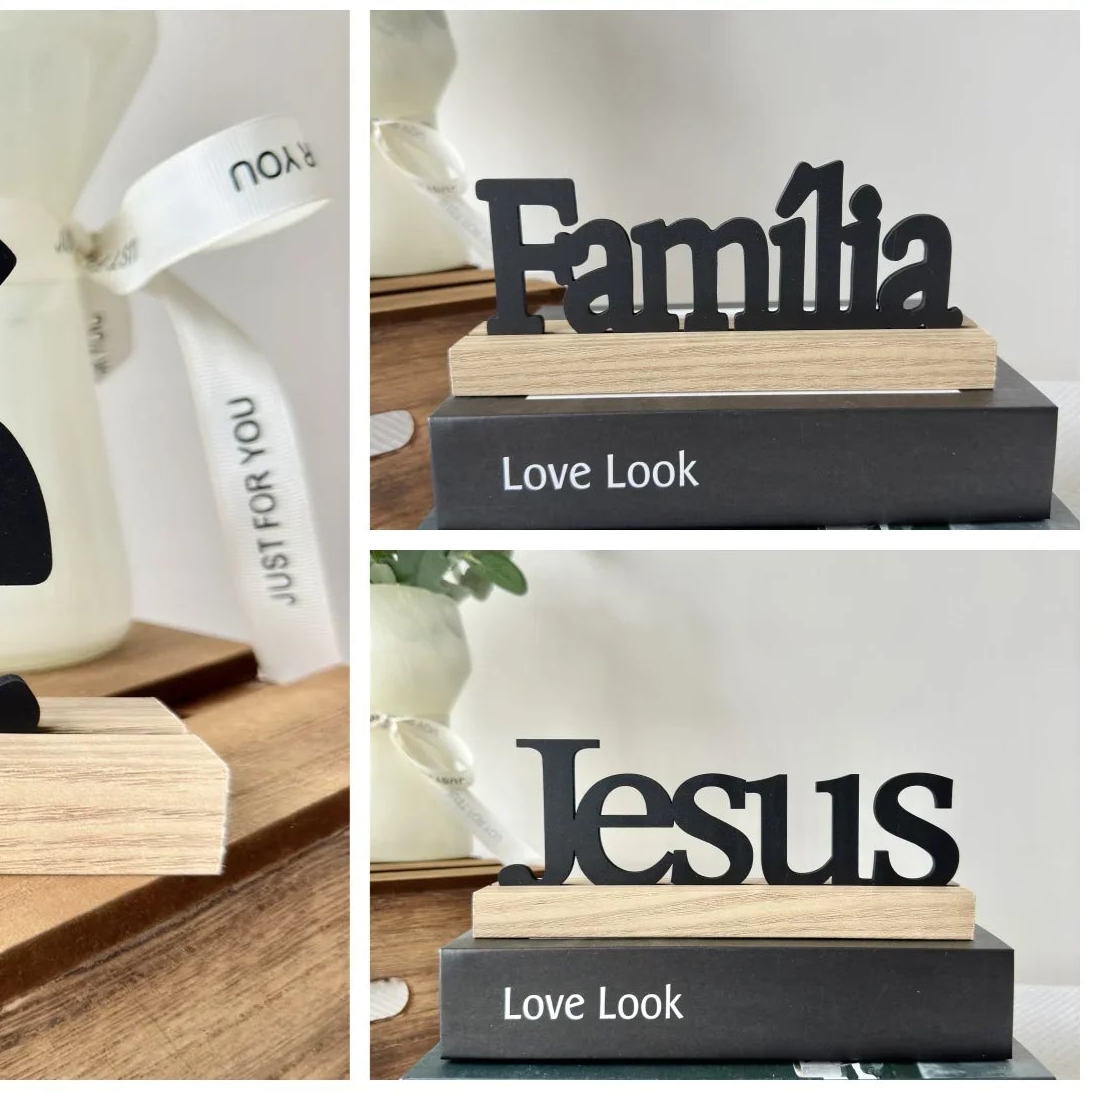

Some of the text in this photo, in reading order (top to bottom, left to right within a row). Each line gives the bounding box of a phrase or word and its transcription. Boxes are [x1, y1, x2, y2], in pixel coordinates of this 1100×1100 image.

[228, 145, 302, 192] YOU
[475, 160, 964, 334] Família
[227, 396, 298, 606] JUST FOR YOU
[502, 450, 700, 491] Love Look
[500, 738, 960, 886] Jesus
[503, 983, 684, 1021] Love Look
